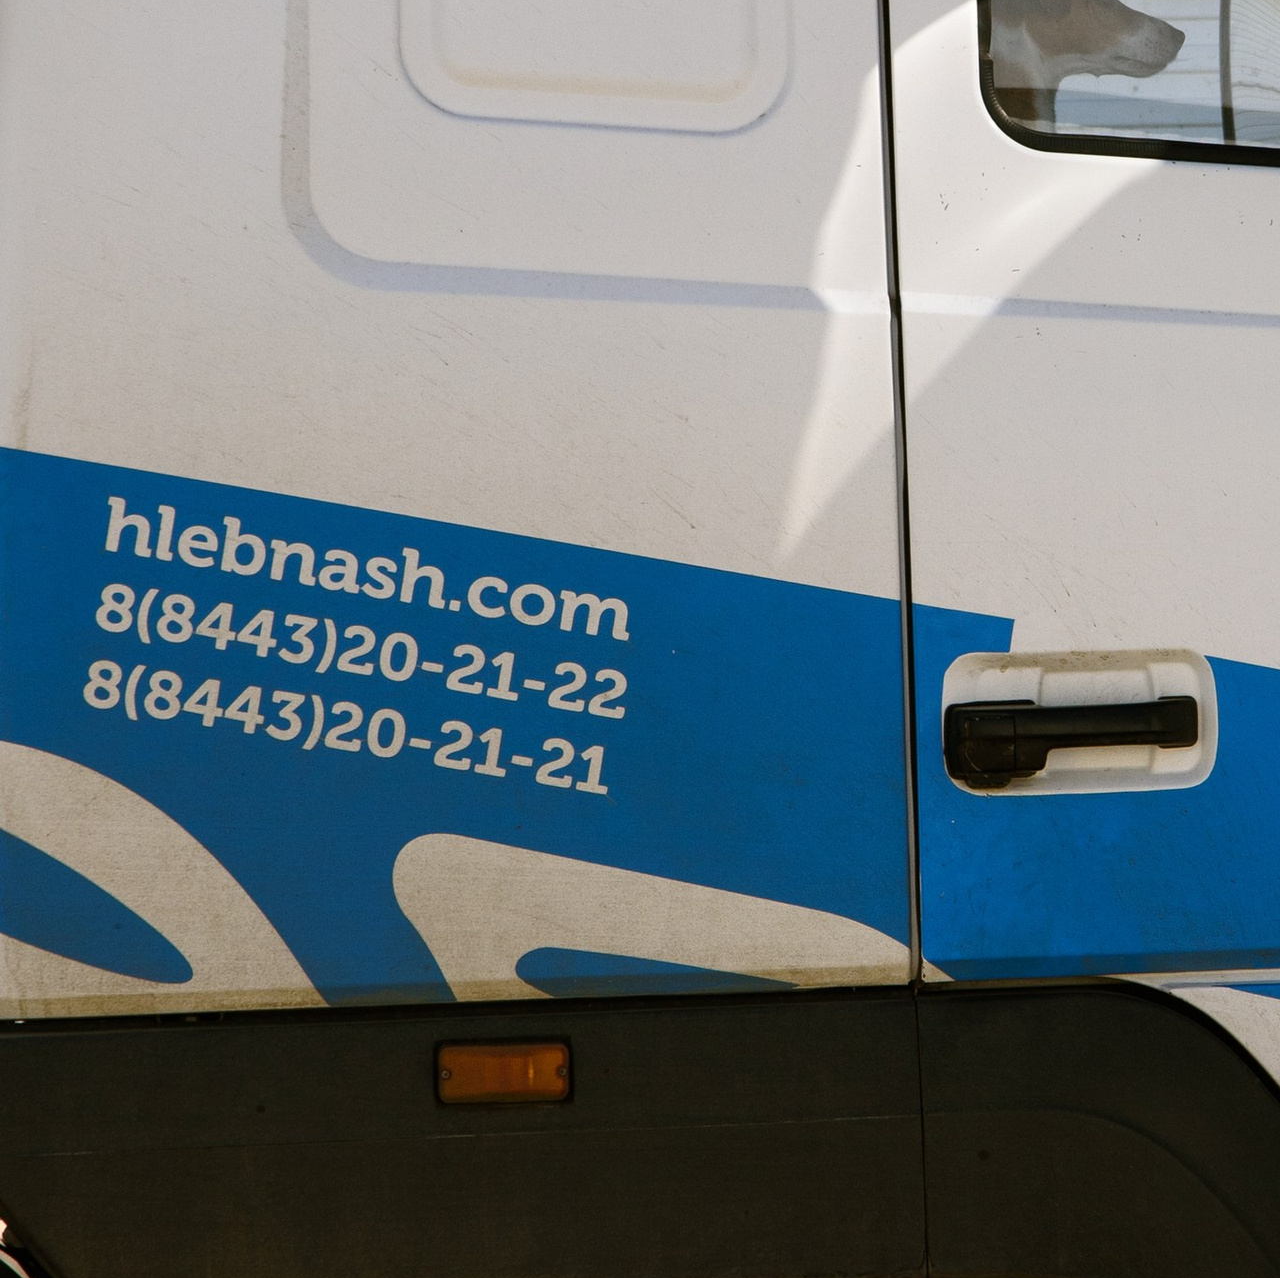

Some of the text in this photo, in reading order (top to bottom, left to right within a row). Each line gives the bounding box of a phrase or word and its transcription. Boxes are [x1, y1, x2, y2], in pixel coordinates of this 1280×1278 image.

[104, 495, 631, 641] hlebnash.com
[95, 583, 628, 720] 8(8443)20-21-22
[82, 660, 608, 795] 8(8443)20-21-21
